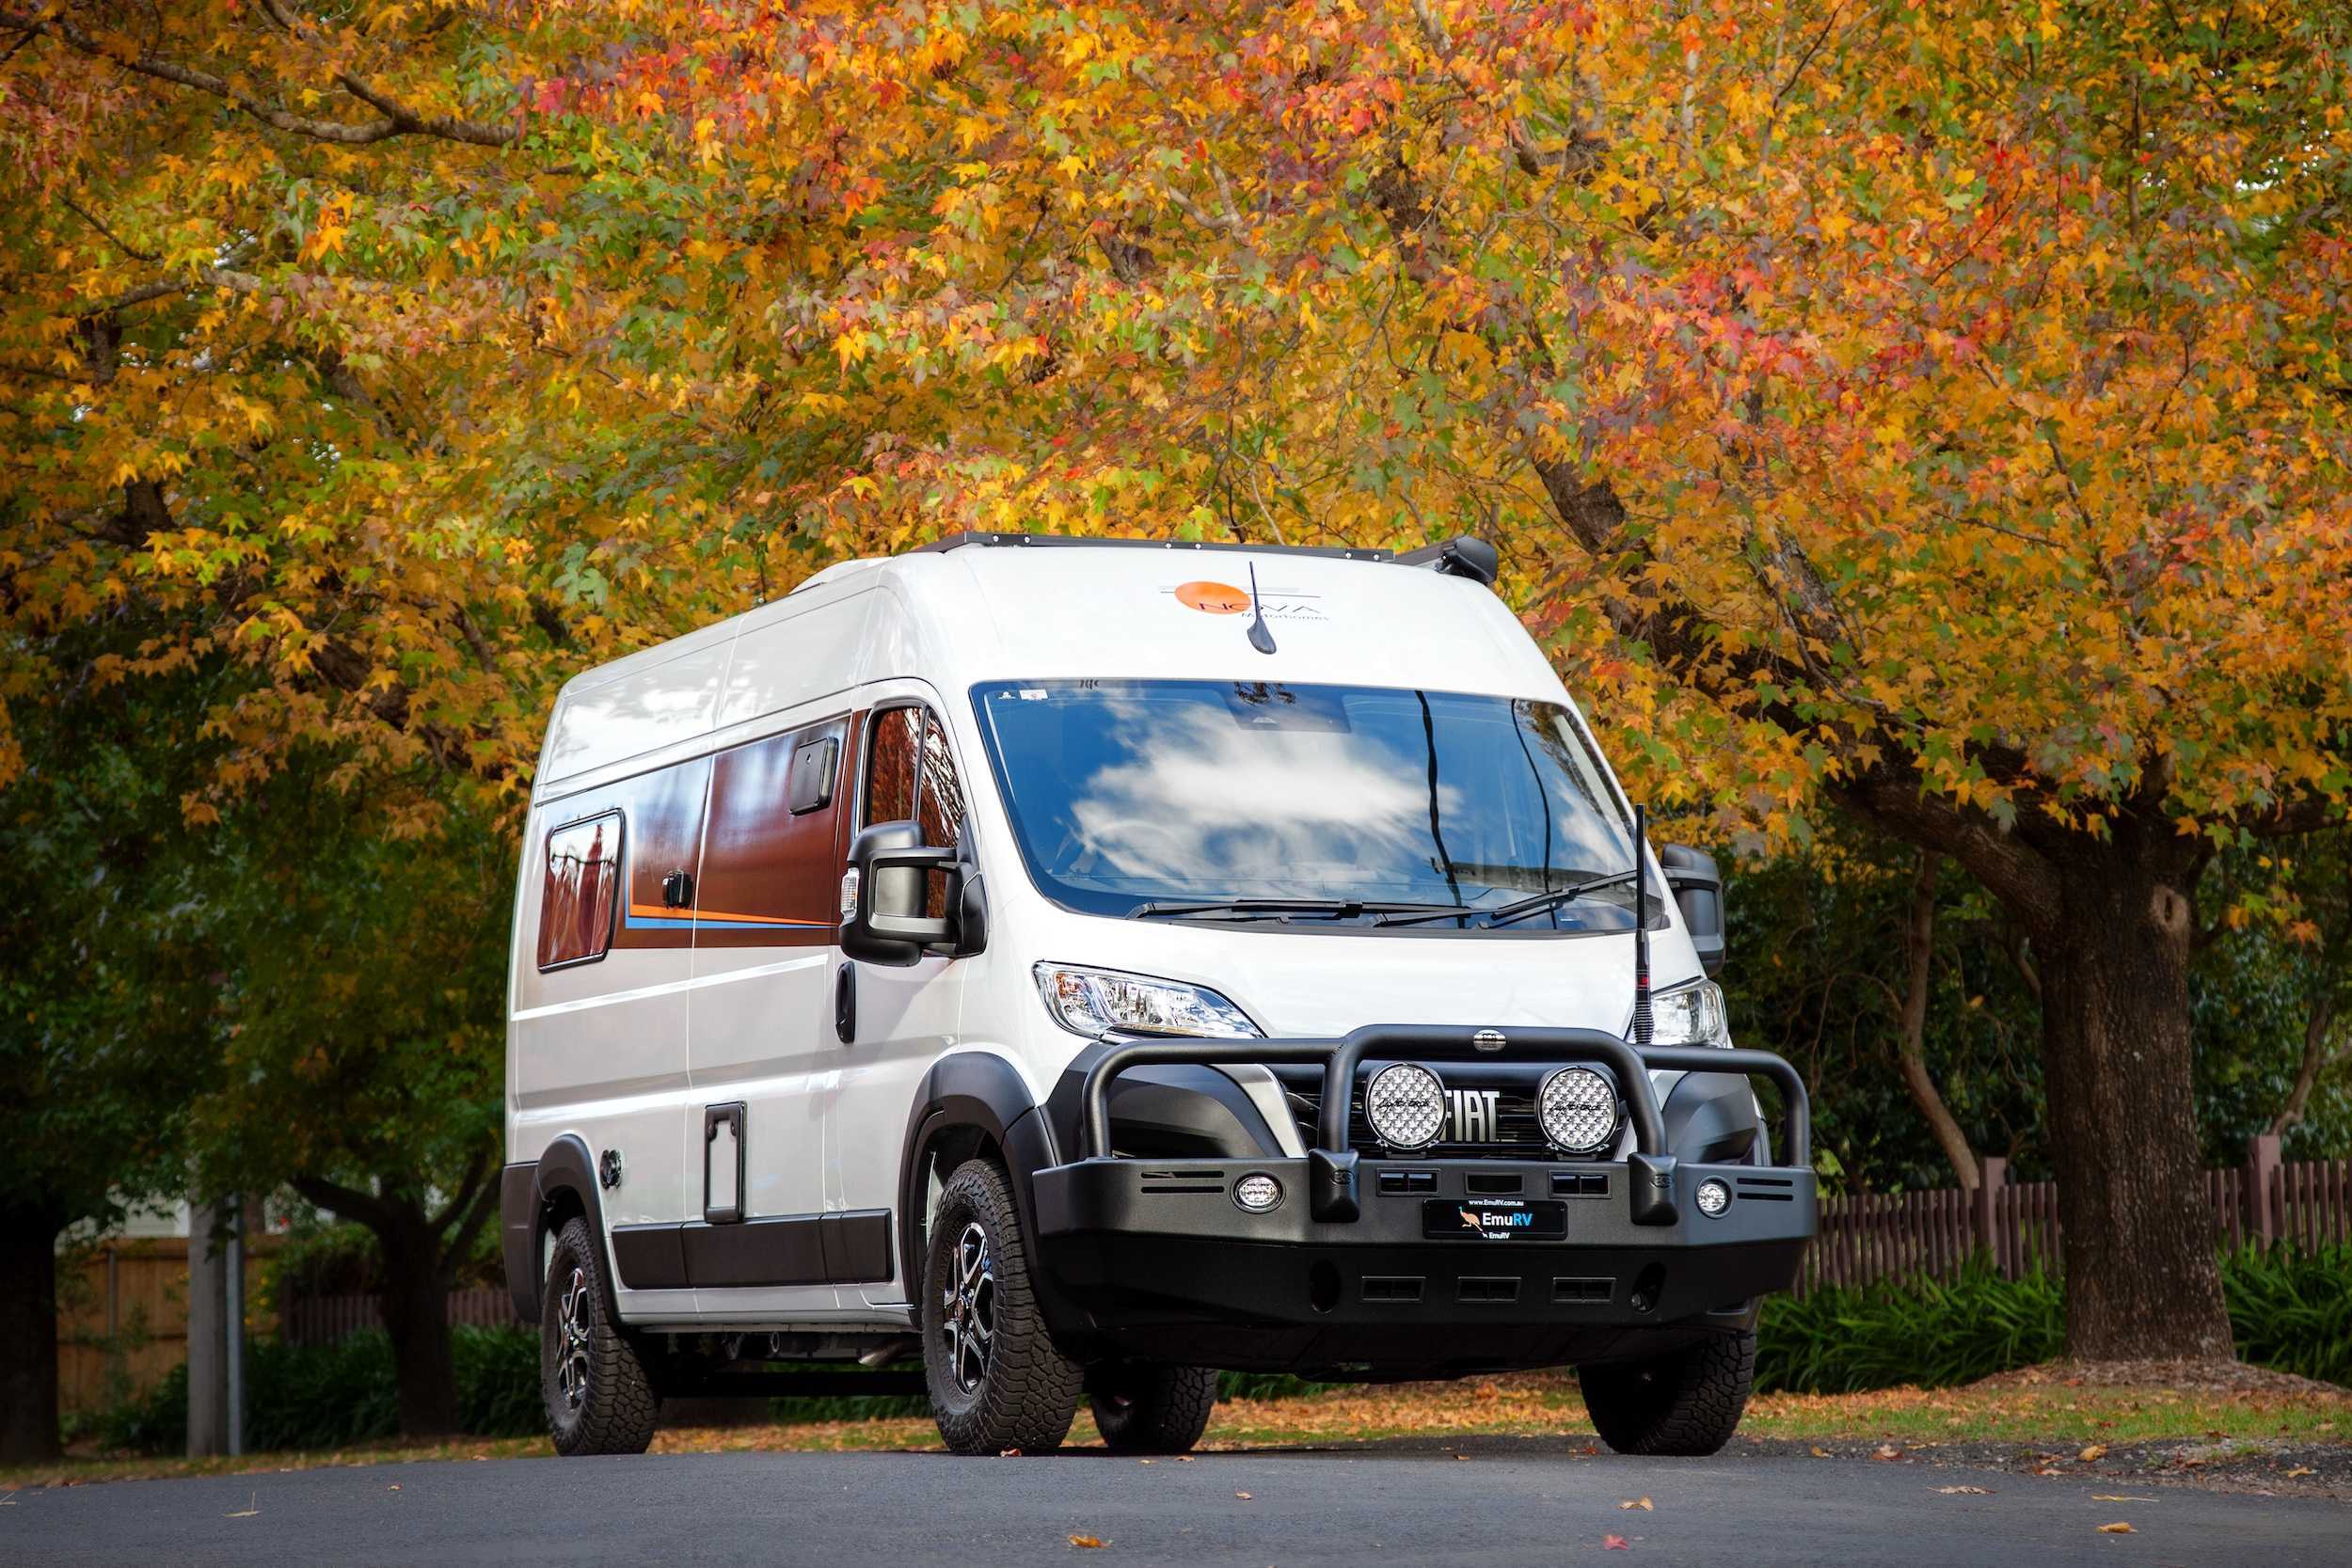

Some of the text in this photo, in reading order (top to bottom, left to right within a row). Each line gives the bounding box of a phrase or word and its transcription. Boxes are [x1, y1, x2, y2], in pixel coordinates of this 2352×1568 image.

[1199, 603, 1320, 614] NOVA
[1241, 611, 1329, 621] Mtorhomes
[1483, 1212, 1533, 1227] EmuRV
